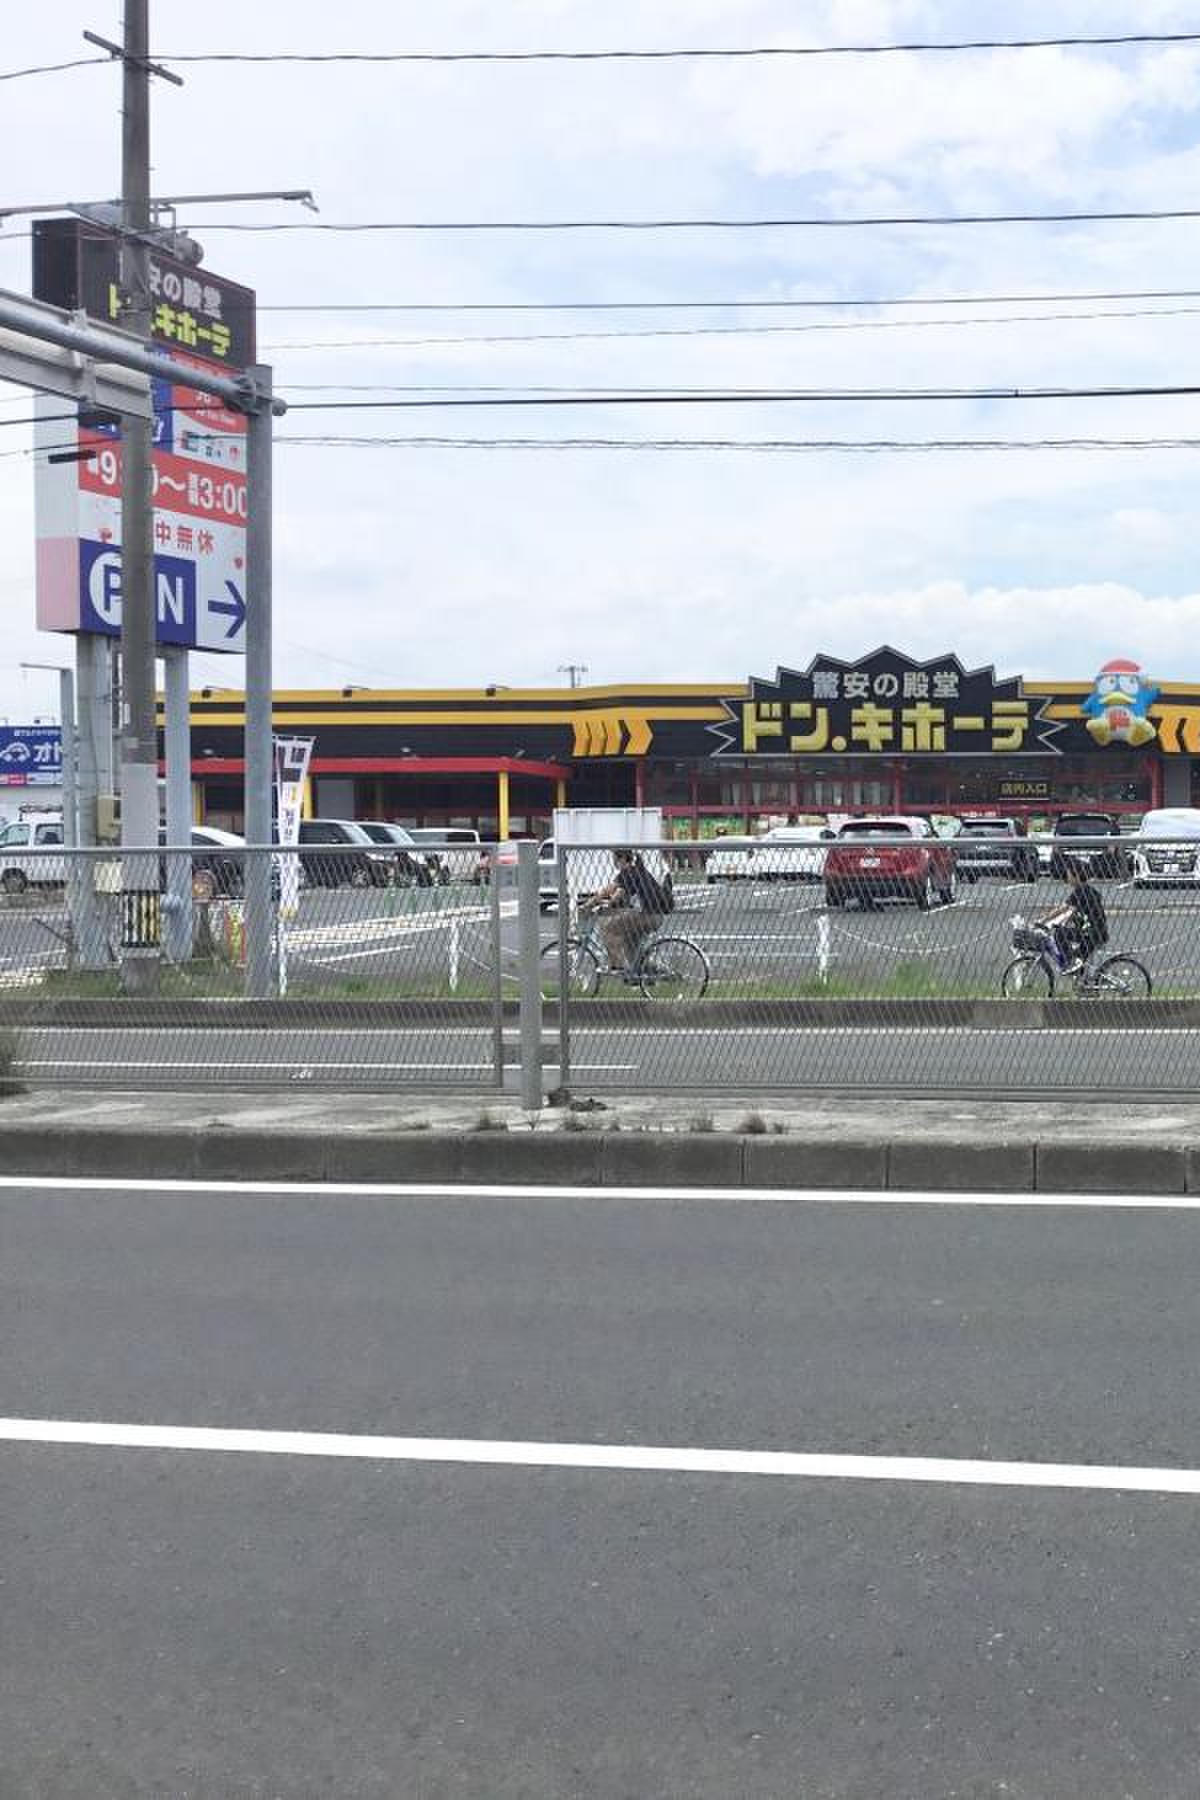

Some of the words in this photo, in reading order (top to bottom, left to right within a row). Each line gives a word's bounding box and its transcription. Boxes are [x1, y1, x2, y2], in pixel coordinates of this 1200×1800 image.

[155, 519, 214, 555] 中無休
[812, 672, 960, 699] 驚安の殿堂
